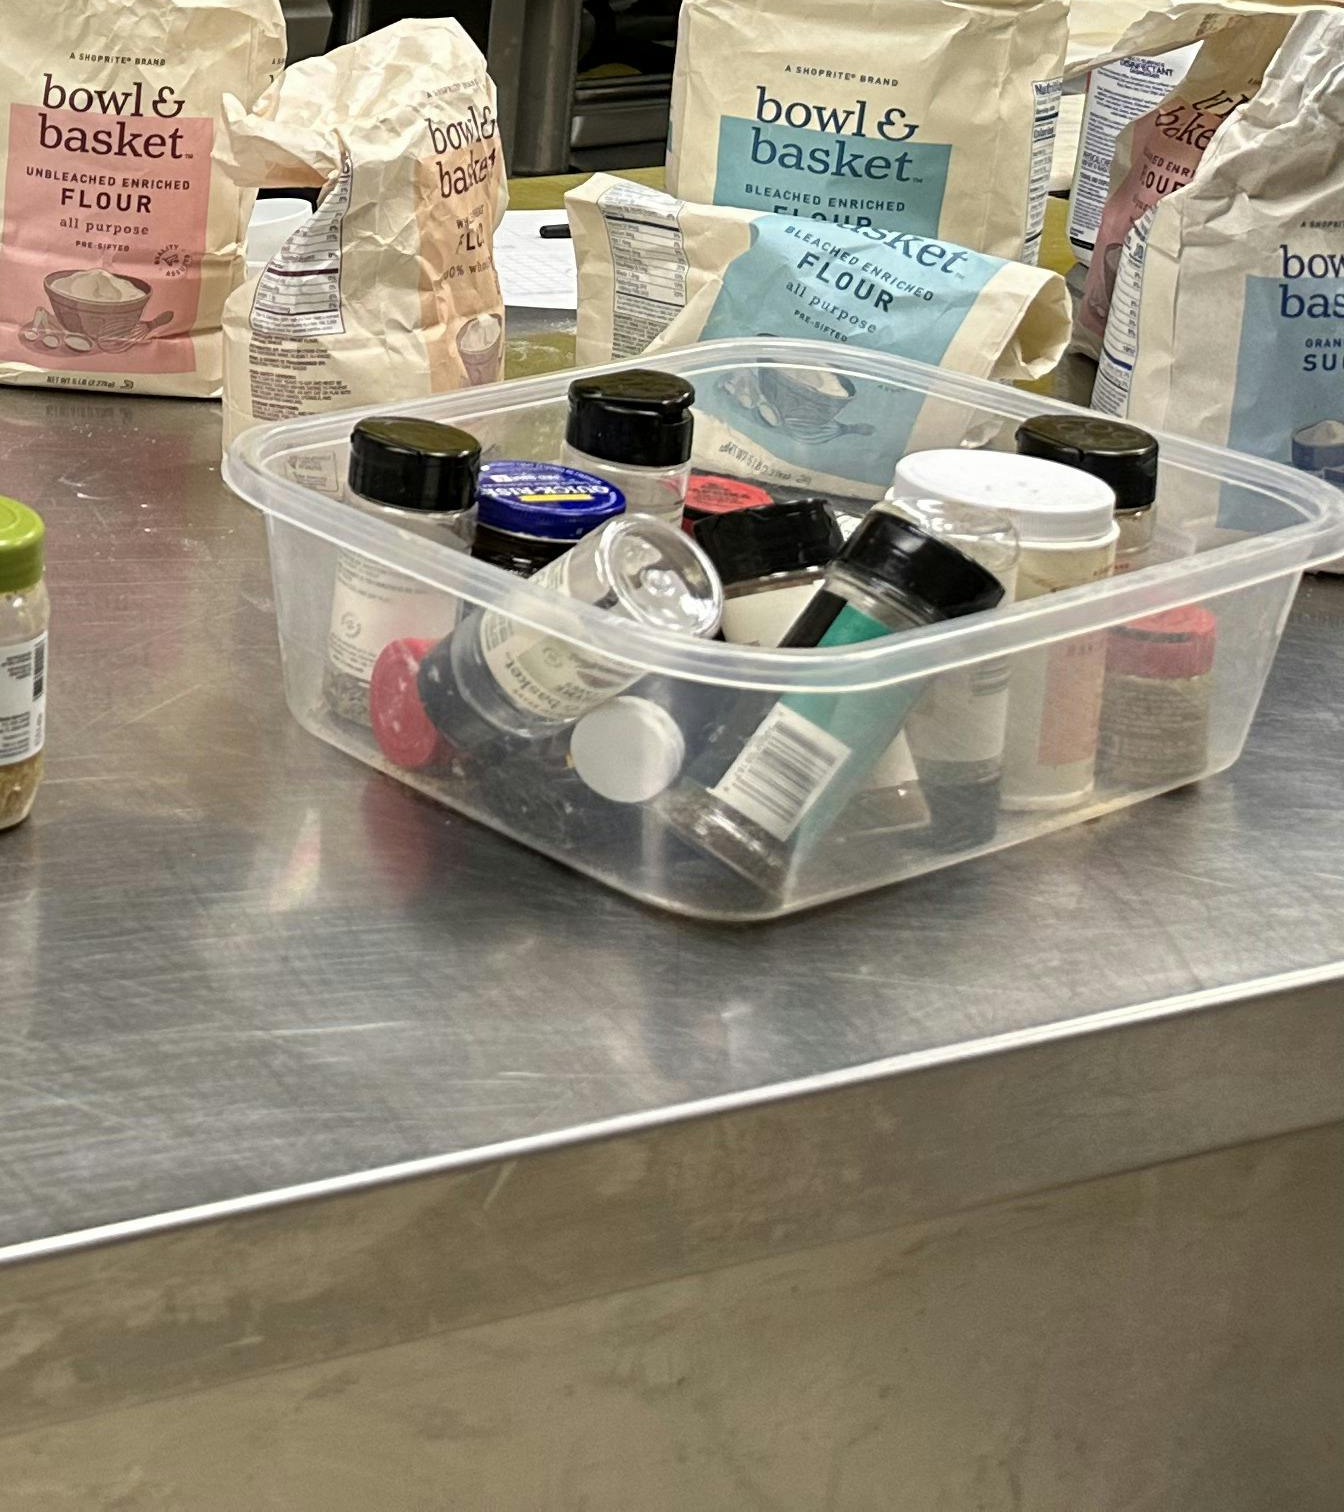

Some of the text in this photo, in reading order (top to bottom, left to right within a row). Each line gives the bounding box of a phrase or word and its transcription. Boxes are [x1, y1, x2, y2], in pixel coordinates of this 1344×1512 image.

[69, 52, 76, 60] A
[135, 57, 166, 67] BRAND
[785, 65, 792, 73] A
[860, 75, 899, 87] BRAND
[43, 73, 185, 119] bowl &
[756, 85, 919, 142] bowl &
[424, 105, 496, 155] bowl &
[26, 166, 190, 191] UNBLEACHED ENRICHED
[1165, 162, 1196, 179] ENRI
[60, 188, 152, 214] FLOUR
[745, 183, 905, 212] BLEACHED ENRICHED
[59, 217, 149, 236] all purpose
[784, 225, 934, 302] BLEACHED ENRICHED
[797, 251, 894, 313] FLOUR
[785, 280, 877, 334] all purpose
[794, 309, 848, 342] PRE-SIFTED
